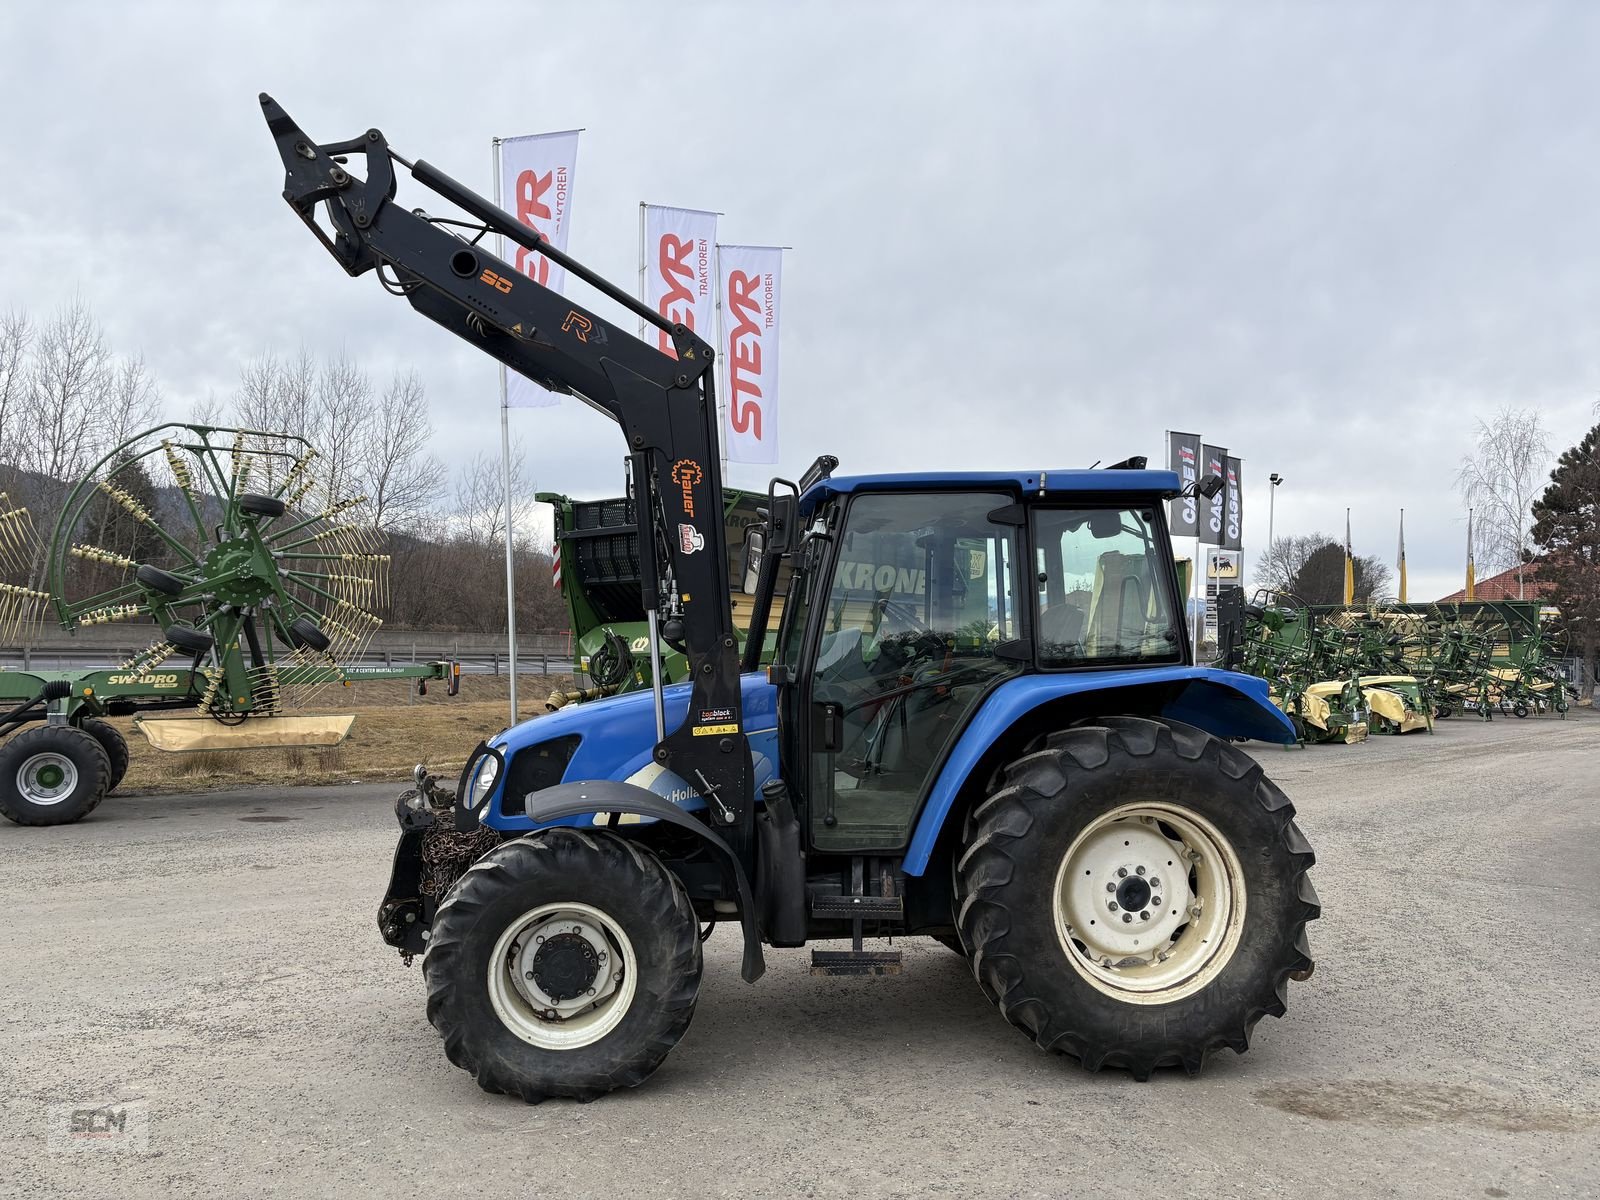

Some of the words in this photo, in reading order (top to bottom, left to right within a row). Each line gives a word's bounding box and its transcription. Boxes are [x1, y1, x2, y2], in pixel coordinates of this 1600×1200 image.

[516, 169, 553, 287] EYR
[699, 239, 708, 296] TRAKTOREN
[765, 273, 774, 329] TRAKTOREN
[728, 269, 763, 441] STEYR
[681, 469, 696, 518] hauer
[1210, 488, 1222, 532] CAS
[1227, 485, 1239, 539] CASE
[702, 710, 730, 718] topblock
[672, 786, 700, 803] Holla
